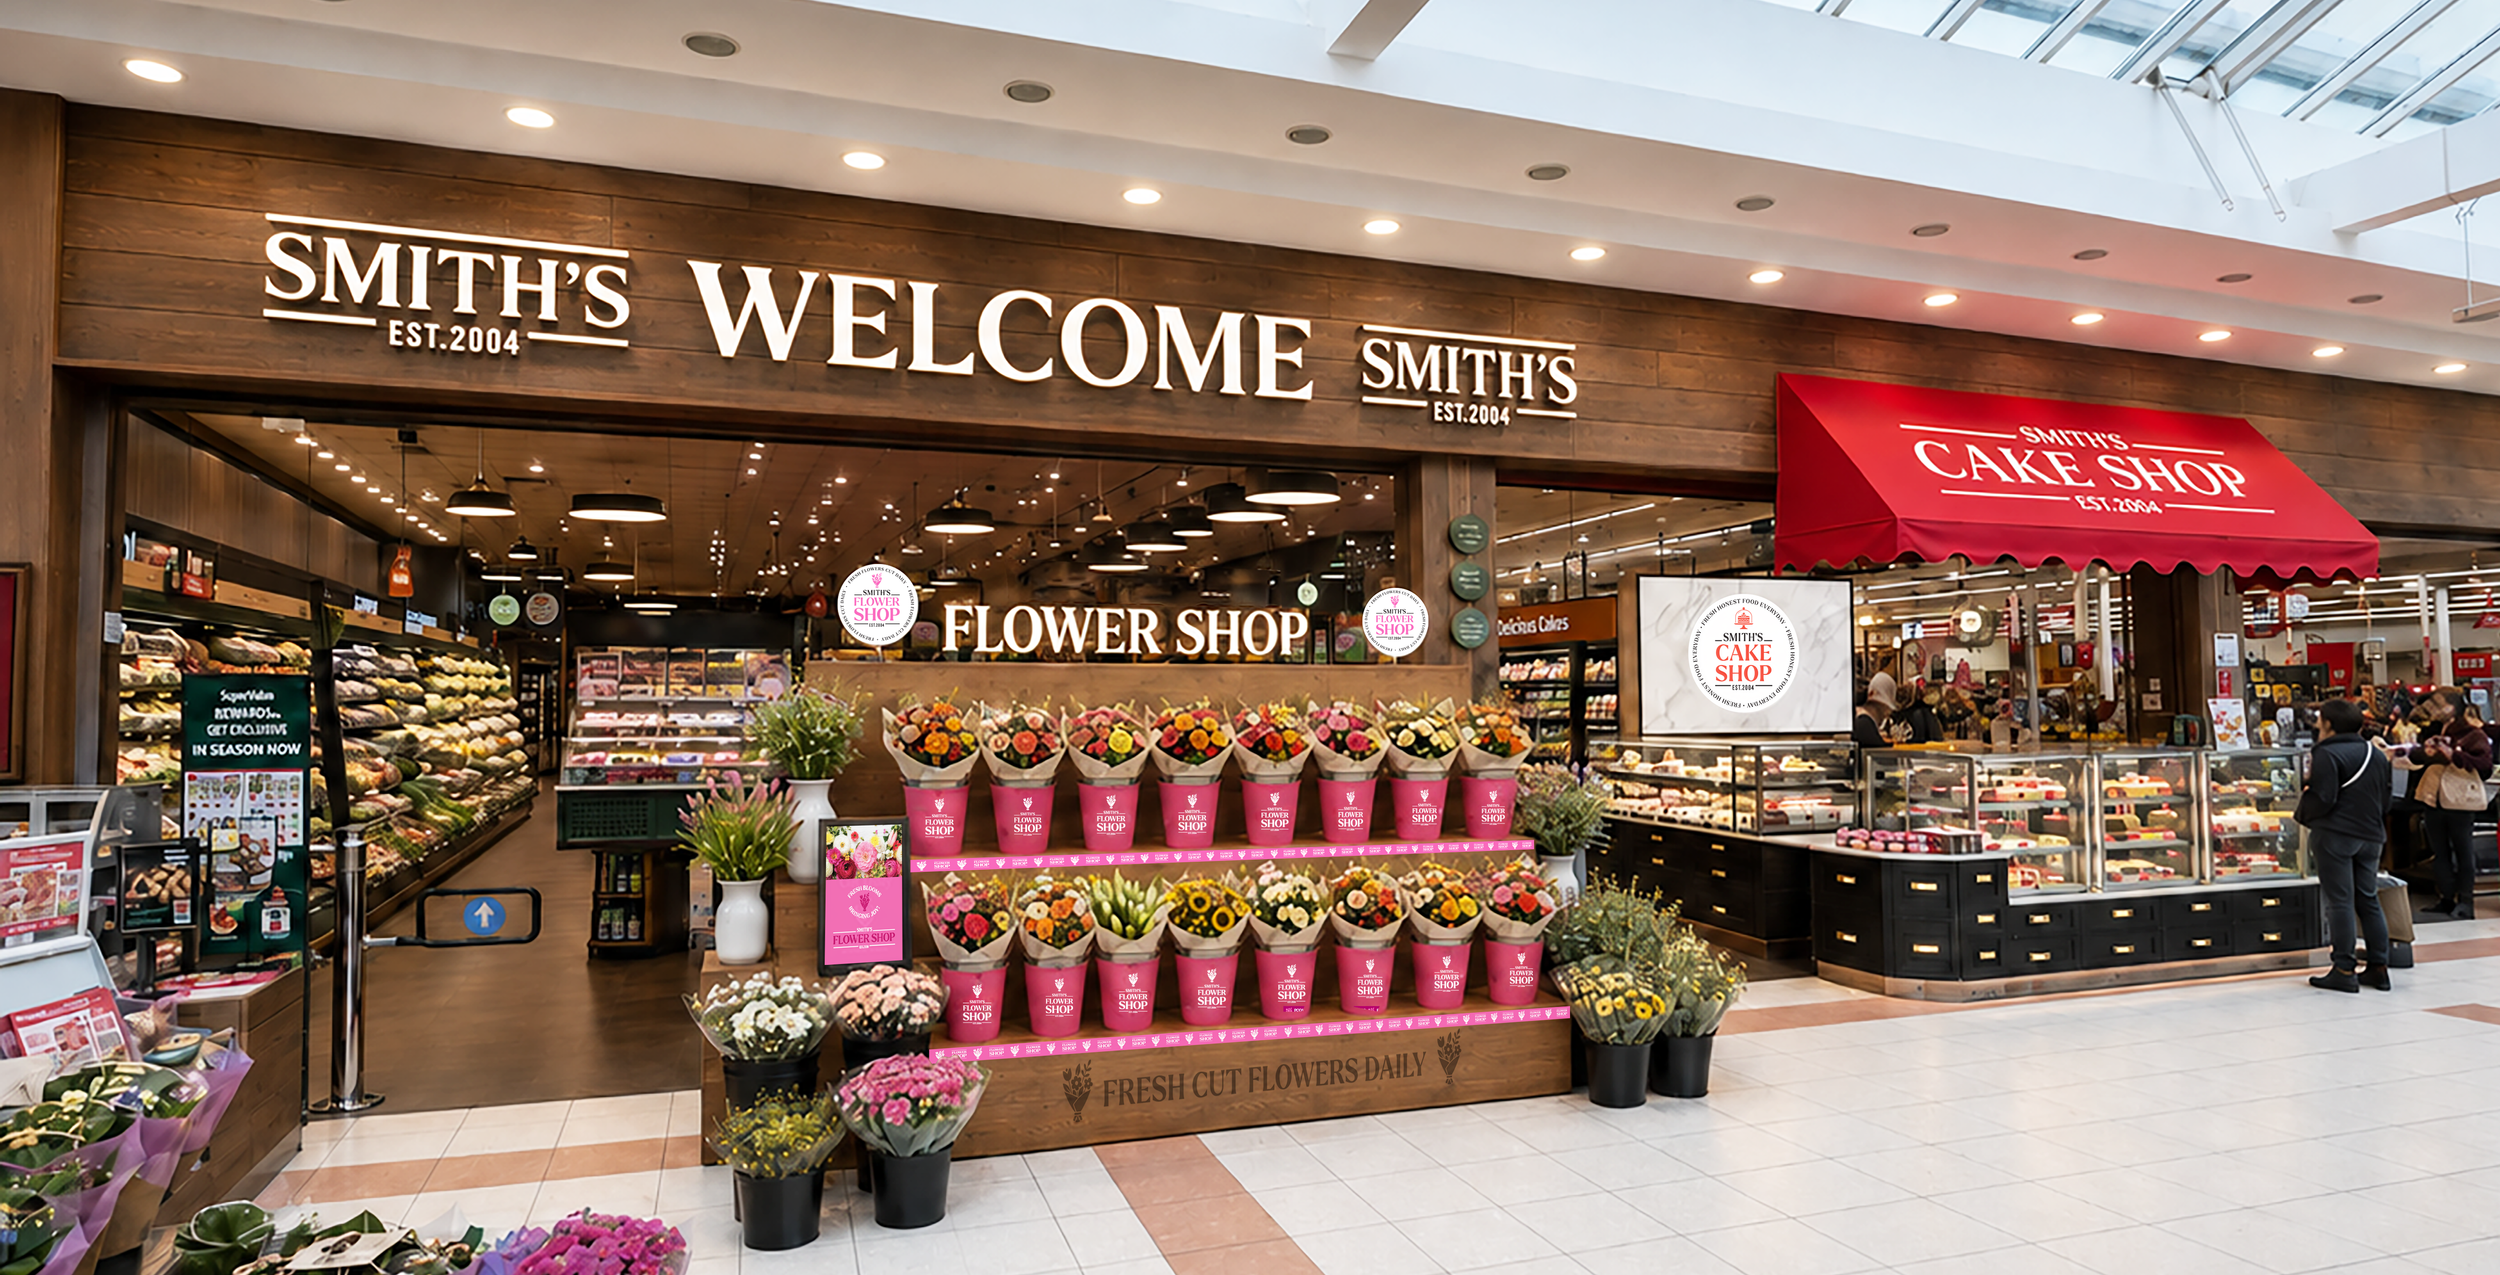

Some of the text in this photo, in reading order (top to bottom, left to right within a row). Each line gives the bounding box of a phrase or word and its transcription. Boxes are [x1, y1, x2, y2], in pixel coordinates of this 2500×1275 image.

[686, 260, 1314, 400] WELCOME
[389, 320, 520, 356] EST.2004
[1433, 401, 1511, 426] EST.2004
[1914, 439, 2246, 498] CAKE SHOP
[2074, 494, 2163, 514] EST.2004
[854, 597, 900, 606] FLOWER
[854, 608, 900, 621] SHOP
[1701, 608, 1718, 626] FRESH
[1717, 598, 1740, 611] HONEST
[1760, 602, 1786, 625] EVERYDAY
[942, 604, 1309, 656] FLOWER SHOP
[1376, 624, 1414, 635] SHOP
[1716, 644, 1772, 661] CAKE
[1692, 630, 1742, 708] FRESH HONEST FOOD EVERYDAY
[1715, 664, 1772, 682] SHOP
[1747, 629, 1795, 708] FRESH HONEST FOOD EVERYDAY
[192, 743, 301, 756] IN SEASON NOW
[1014, 824, 1041, 832] SHOP
[1097, 823, 1125, 831] SHOP
[1178, 822, 1207, 830] SHOP
[1261, 819, 1289, 827] SHOP
[1338, 819, 1363, 827] SHOP
[925, 826, 954, 835] SHOP
[847, 886, 862, 898] FRESH
[833, 932, 895, 945] FLOWER SHOP
[1278, 991, 1306, 999] SHOP
[1358, 986, 1383, 994] SHOP
[1119, 1001, 1148, 1009] SHOP
[1198, 997, 1226, 1005] SHOP
[1046, 1005, 1073, 1013] SHOP
[963, 1012, 992, 1020] SHOP
[1103, 1051, 1426, 1108] FRESH CUT FLOWERS DAILY
